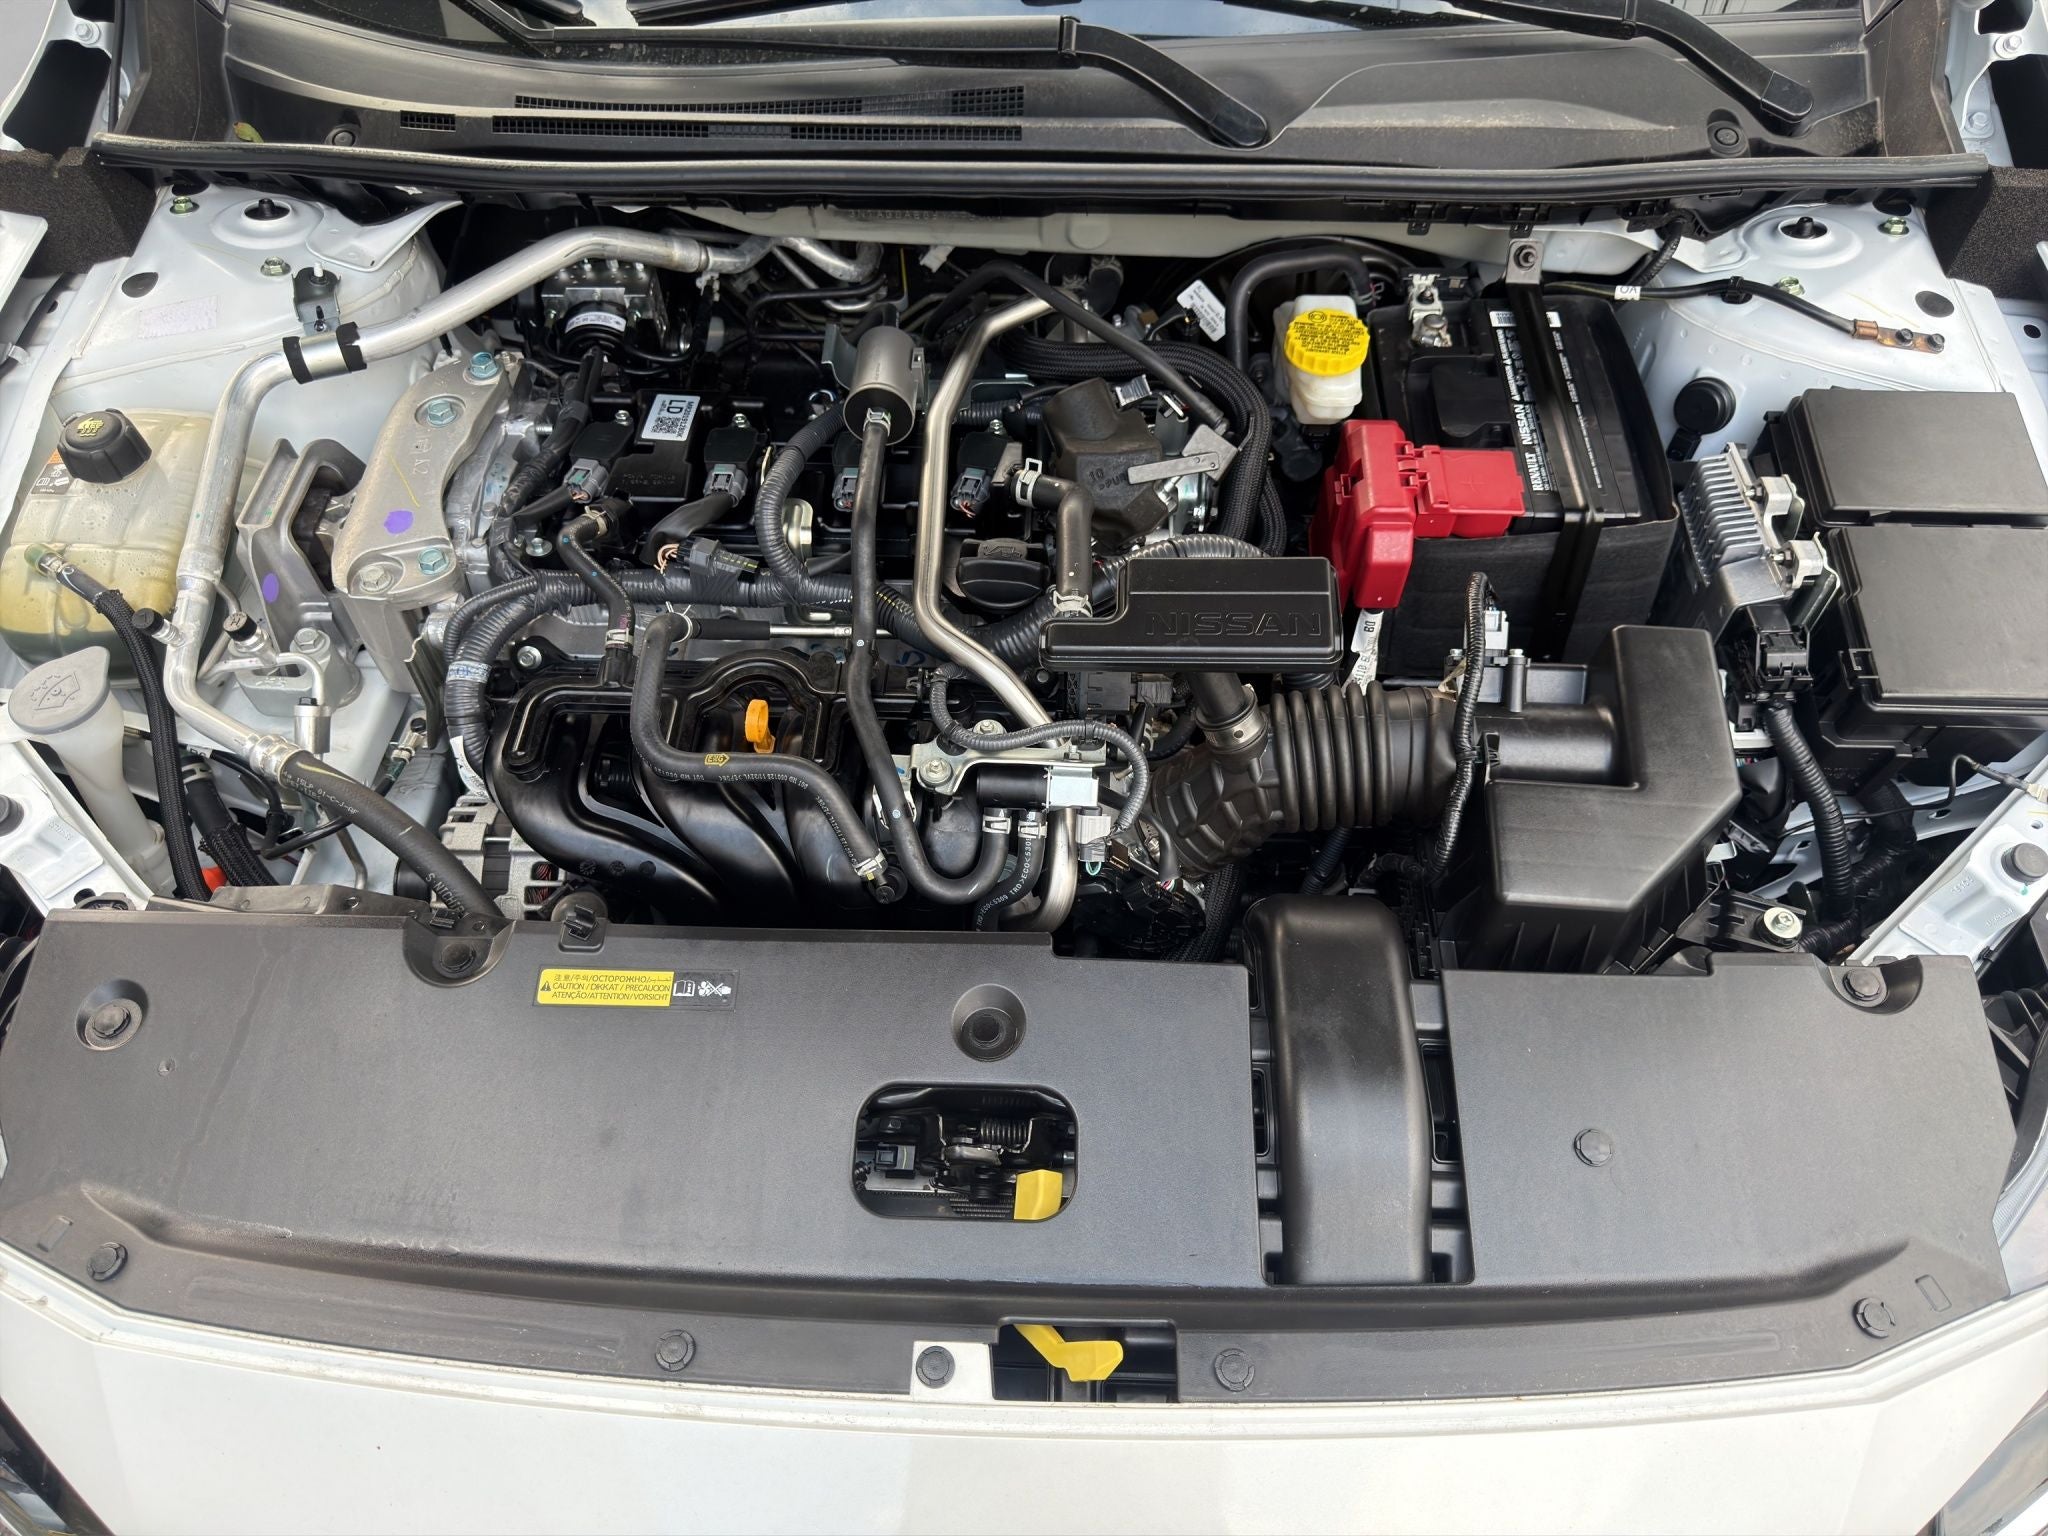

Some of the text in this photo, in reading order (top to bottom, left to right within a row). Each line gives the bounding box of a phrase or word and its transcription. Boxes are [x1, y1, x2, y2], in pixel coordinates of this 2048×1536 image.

[667, 399, 687, 415] LD
[1514, 404, 1533, 445] NISSAN
[1523, 450, 1544, 492] RENAULT
[1145, 612, 1322, 636] NISSAN
[553, 982, 584, 990] CAUTION
